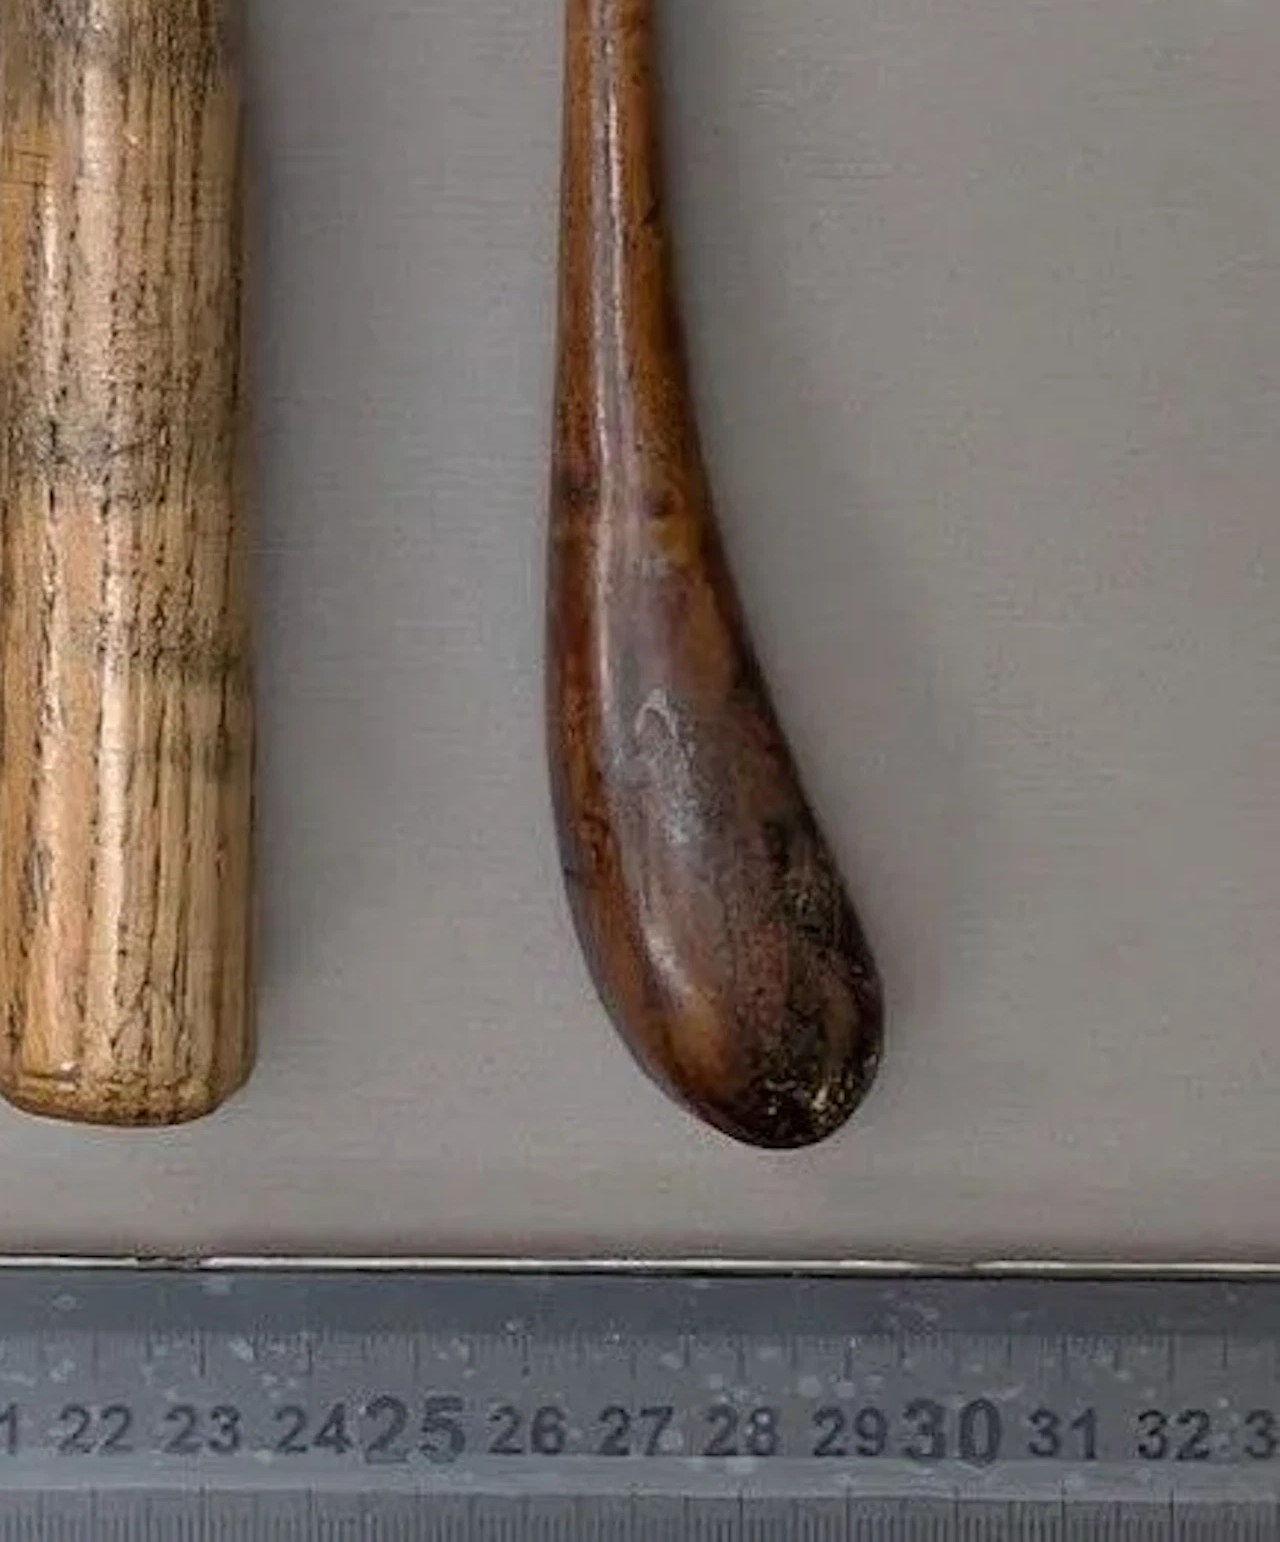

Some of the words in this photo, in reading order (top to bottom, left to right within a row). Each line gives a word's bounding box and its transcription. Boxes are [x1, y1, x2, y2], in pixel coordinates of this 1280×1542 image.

[58, 1403, 133, 1455] 22
[163, 1403, 241, 1456] 23
[275, 1403, 351, 1456] 24
[363, 1394, 466, 1464] 25
[487, 1405, 566, 1457] 26
[597, 1405, 676, 1458] 27
[703, 1406, 782, 1458] 28
[812, 1407, 888, 1458] 29
[901, 1398, 1001, 1467] 30
[1029, 1407, 1098, 1459] 31
[1138, 1409, 1210, 1460] 32
